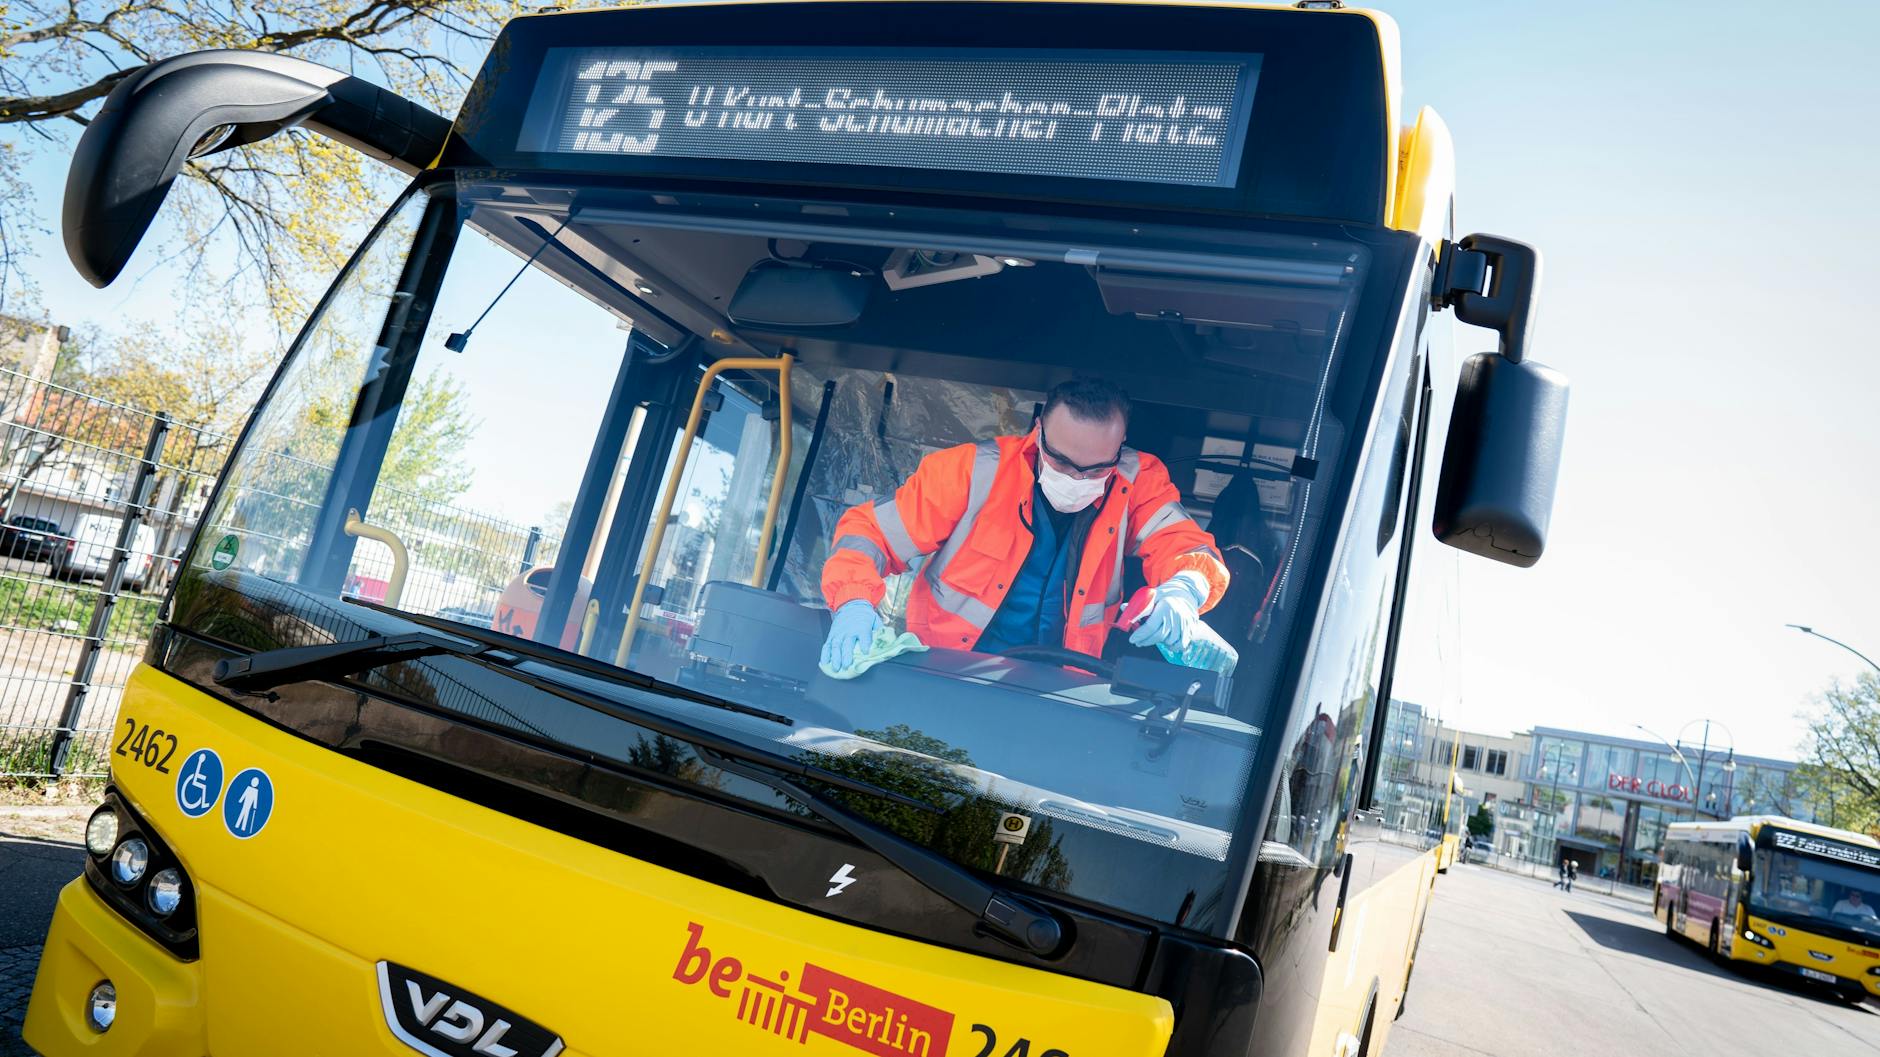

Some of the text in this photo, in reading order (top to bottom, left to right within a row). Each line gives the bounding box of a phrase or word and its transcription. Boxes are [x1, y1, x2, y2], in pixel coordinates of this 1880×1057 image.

[573, 60, 678, 153] 125
[684, 85, 1223, 146] U Kurt-Schumacher-Platz
[115, 718, 178, 775] 2462
[406, 979, 518, 1057] VDL
[672, 921, 743, 998] be
[821, 988, 931, 1057] Berlin
